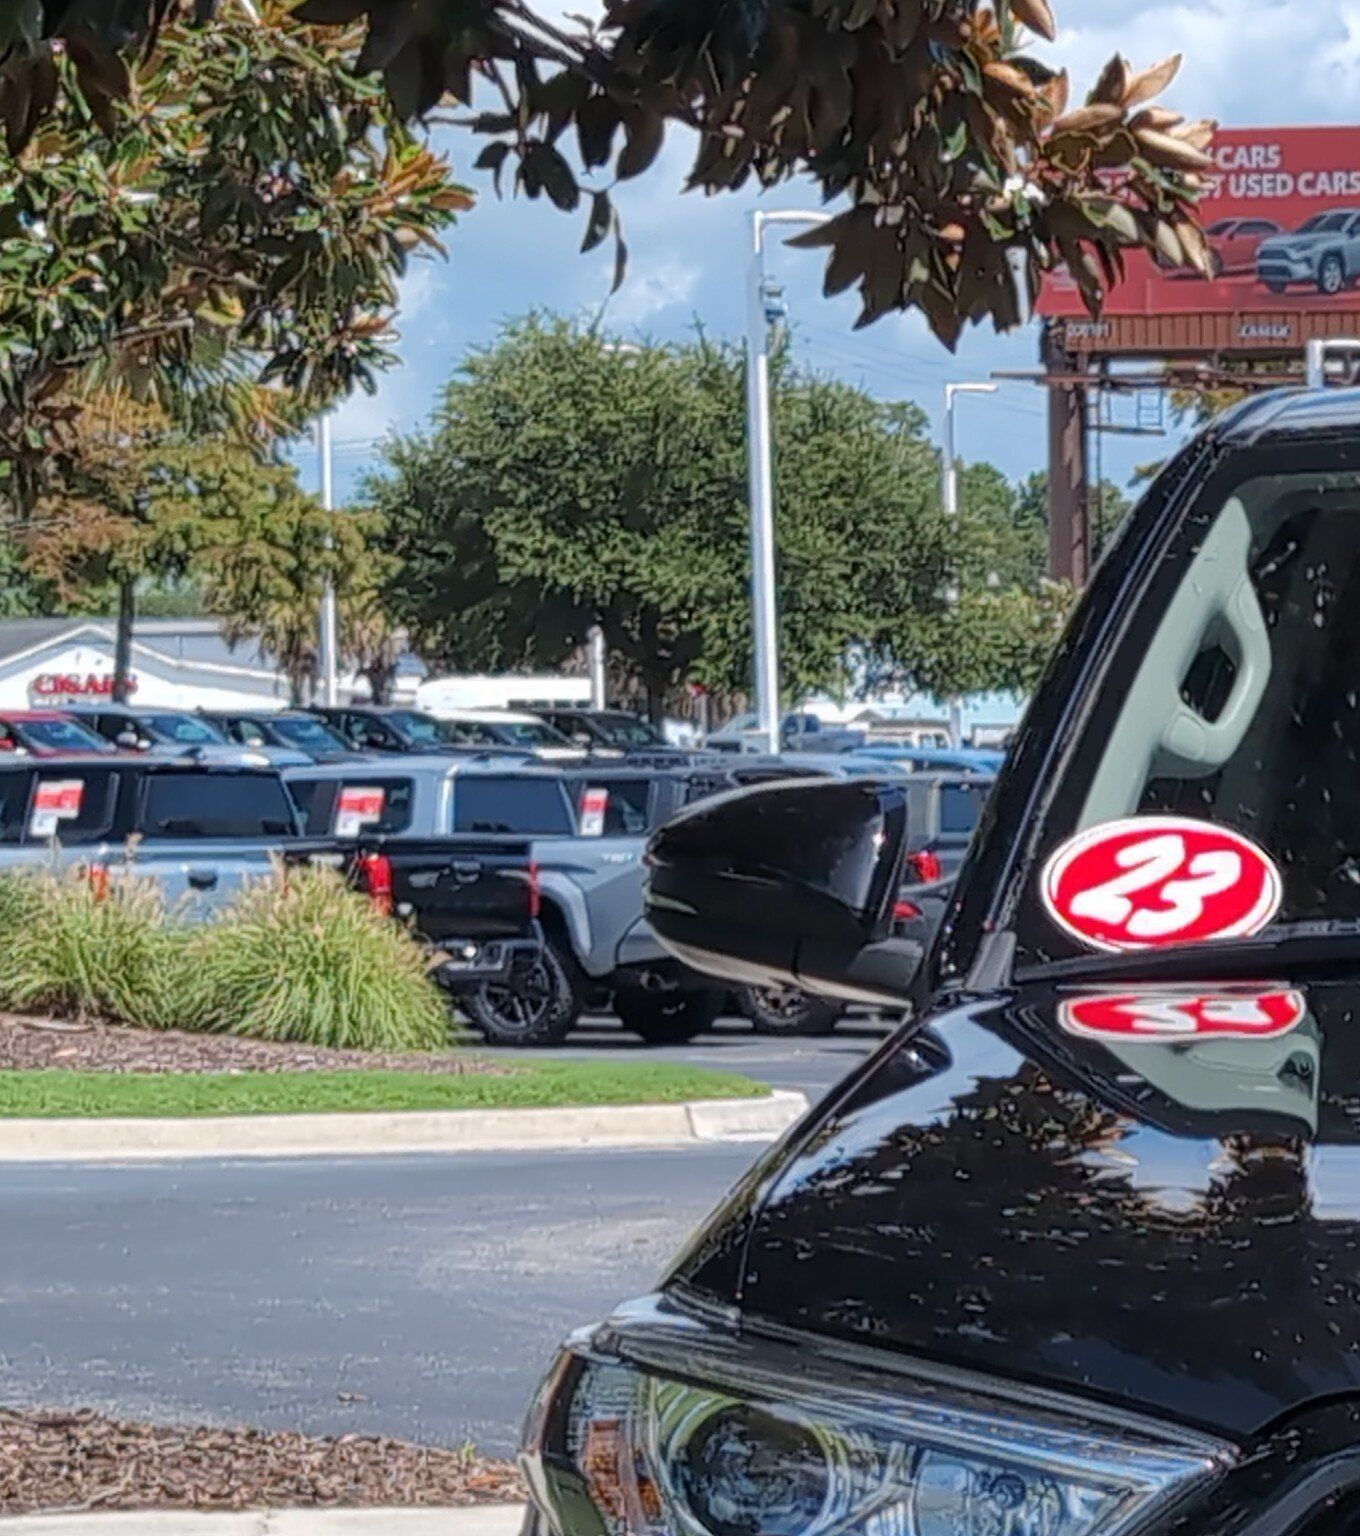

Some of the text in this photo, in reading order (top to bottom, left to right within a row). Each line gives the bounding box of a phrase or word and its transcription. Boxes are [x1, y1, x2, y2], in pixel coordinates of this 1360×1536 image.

[1215, 144, 1281, 168] CARS
[1228, 172, 1295, 198] USED
[1068, 833, 1242, 936] 23
